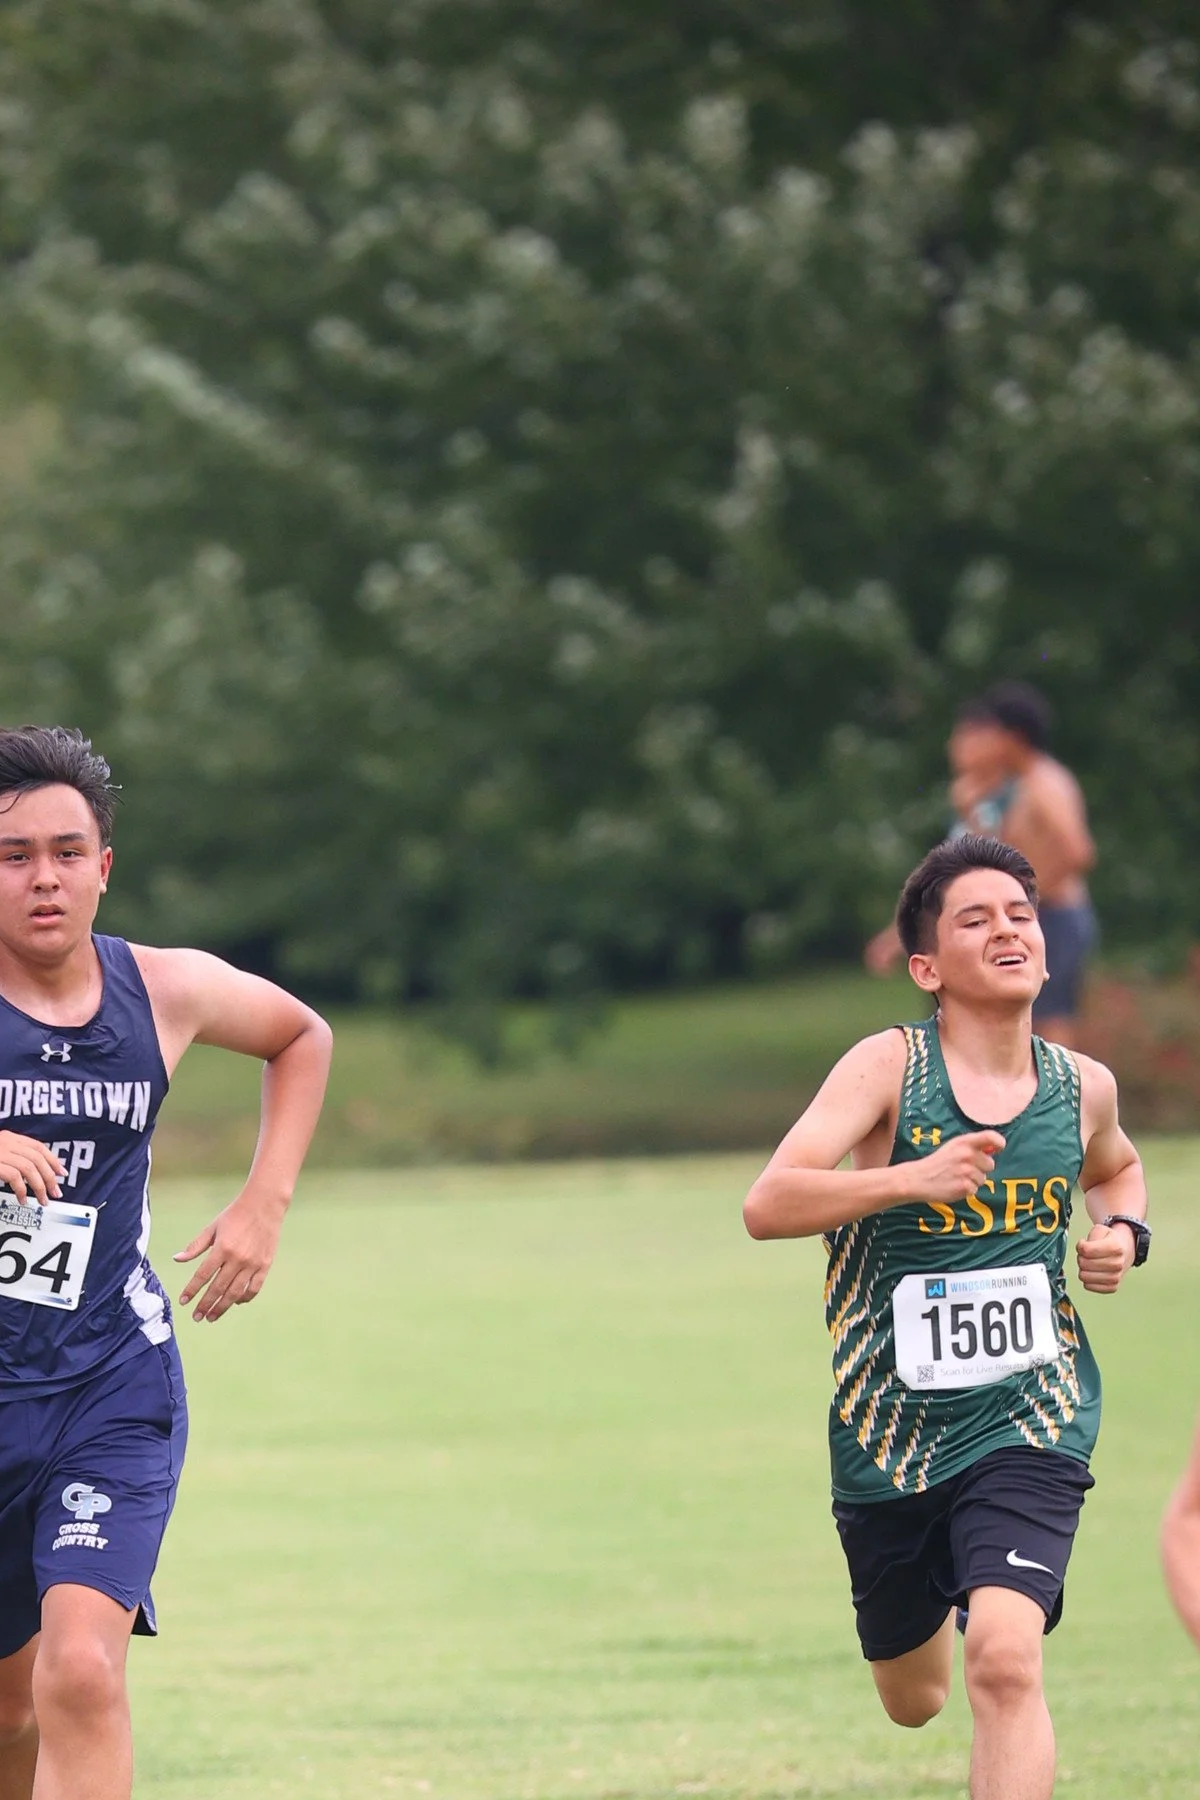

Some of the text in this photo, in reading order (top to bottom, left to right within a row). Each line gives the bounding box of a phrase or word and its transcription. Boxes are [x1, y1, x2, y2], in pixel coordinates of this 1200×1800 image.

[918, 1176, 1068, 1237] SSFS
[1, 1212, 37, 1227] CLASSIC
[921, 1297, 1035, 1361] 1560
[940, 1362, 1025, 1377] Scan for Live Results
[58, 1522, 101, 1536] CROSS
[52, 1534, 109, 1551] COUNTRY
